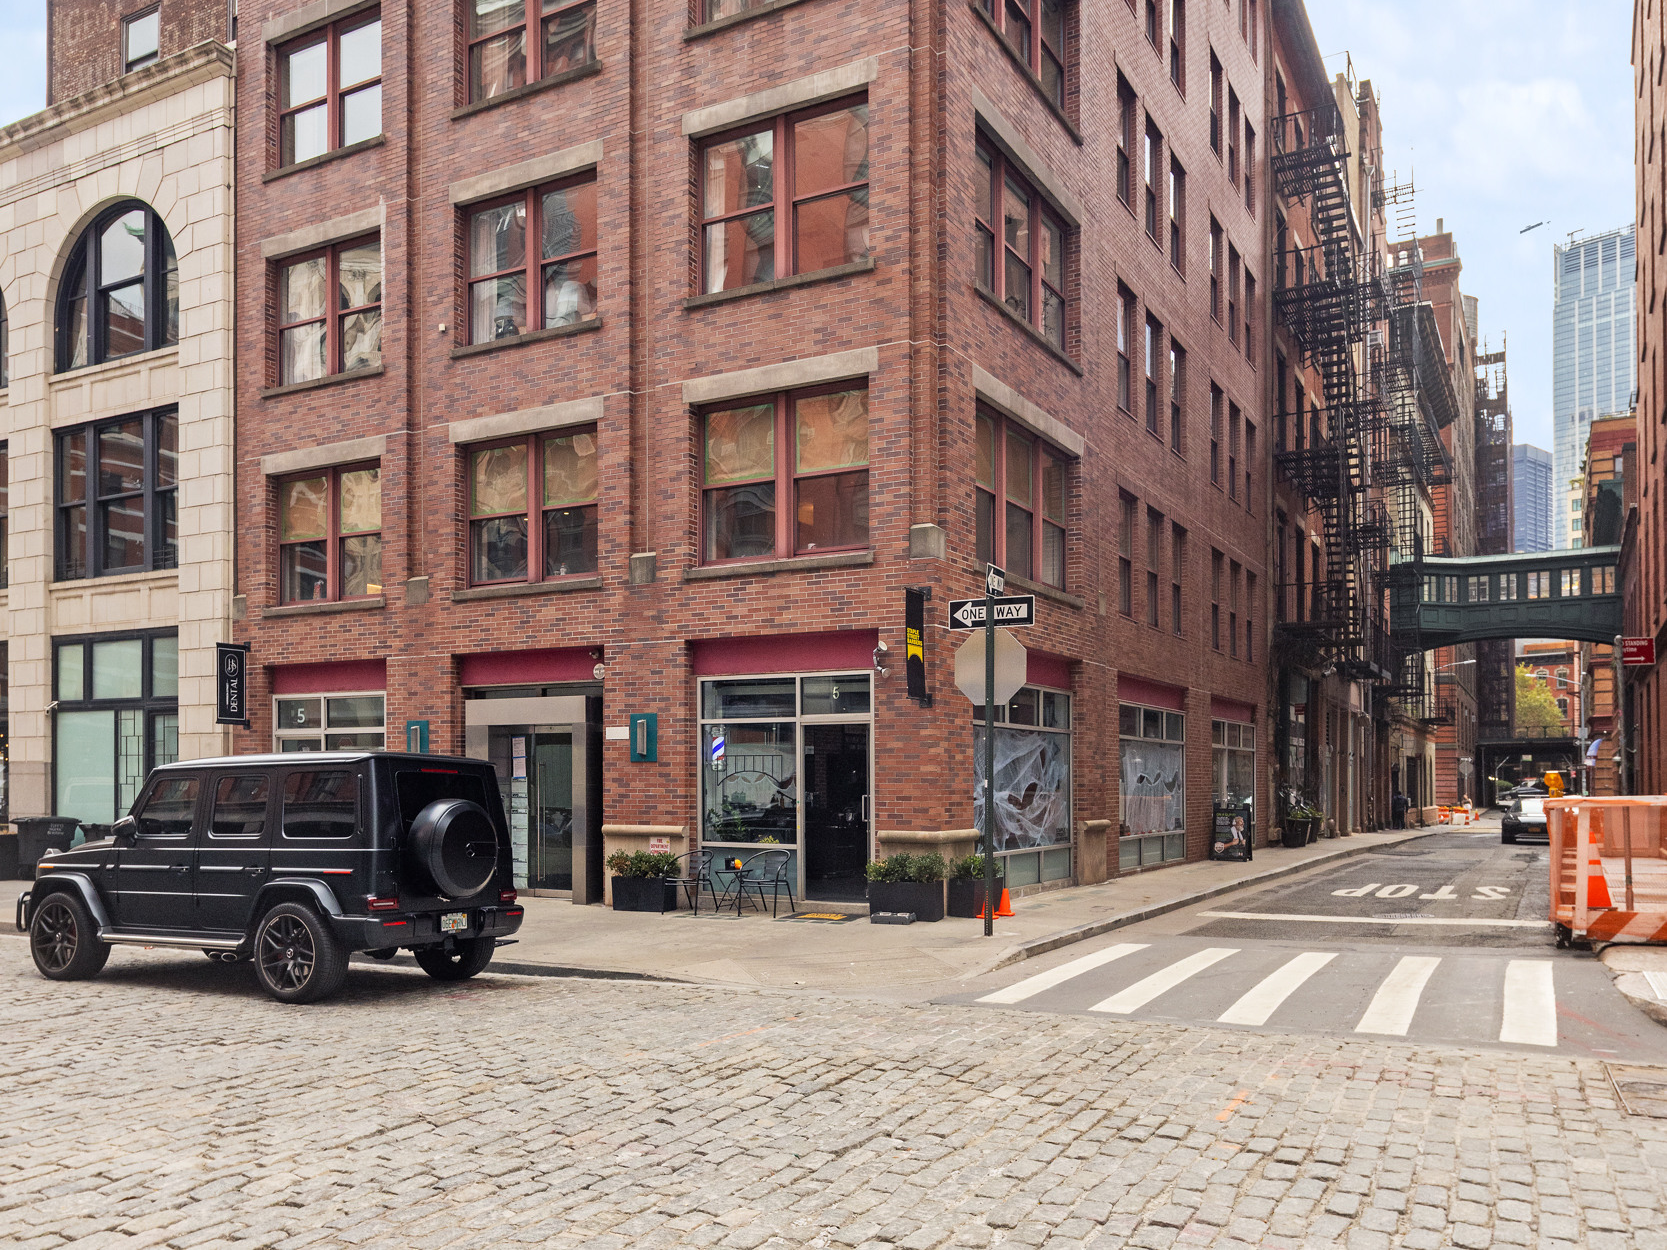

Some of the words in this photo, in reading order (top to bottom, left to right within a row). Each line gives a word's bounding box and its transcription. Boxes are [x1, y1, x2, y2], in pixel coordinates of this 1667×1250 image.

[961, 607, 985, 620] ONE
[996, 605, 1022, 618] WAY
[230, 678, 238, 712] DENTAL
[833, 686, 840, 699] 5
[297, 708, 306, 723] 5
[1331, 883, 1511, 900] STOP
